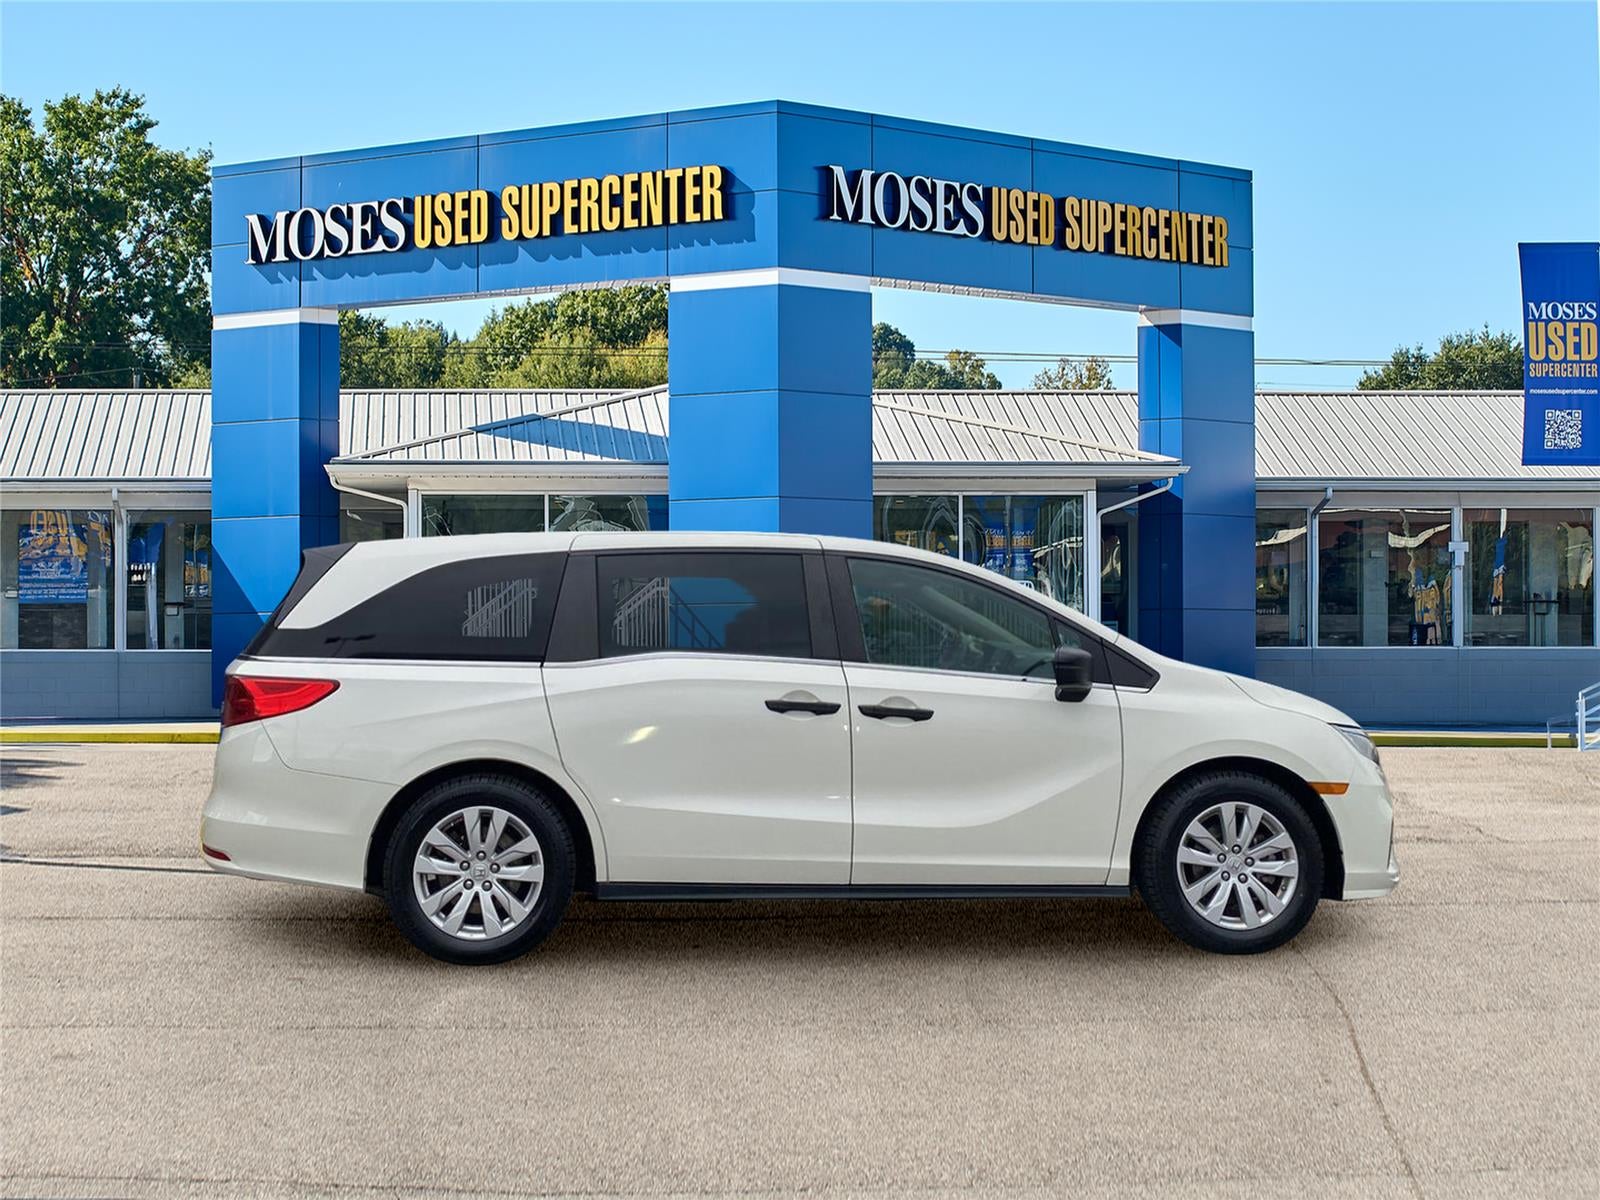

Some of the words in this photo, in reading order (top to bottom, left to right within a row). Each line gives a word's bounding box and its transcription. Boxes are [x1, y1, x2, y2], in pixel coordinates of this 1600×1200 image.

[244, 197, 407, 265] MOSES
[413, 189, 489, 249] USED
[501, 164, 725, 242] SUPERCENTER
[827, 164, 985, 239] MOSES
[991, 186, 1055, 246] USED
[1064, 195, 1230, 268] SUPERCENTER
[1527, 302, 1597, 320] MOSES
[1528, 321, 1598, 361] USED
[1529, 363, 1598, 378] SUPERCENTER
[1529, 388, 1598, 396] mosesusedsupercenter.com
